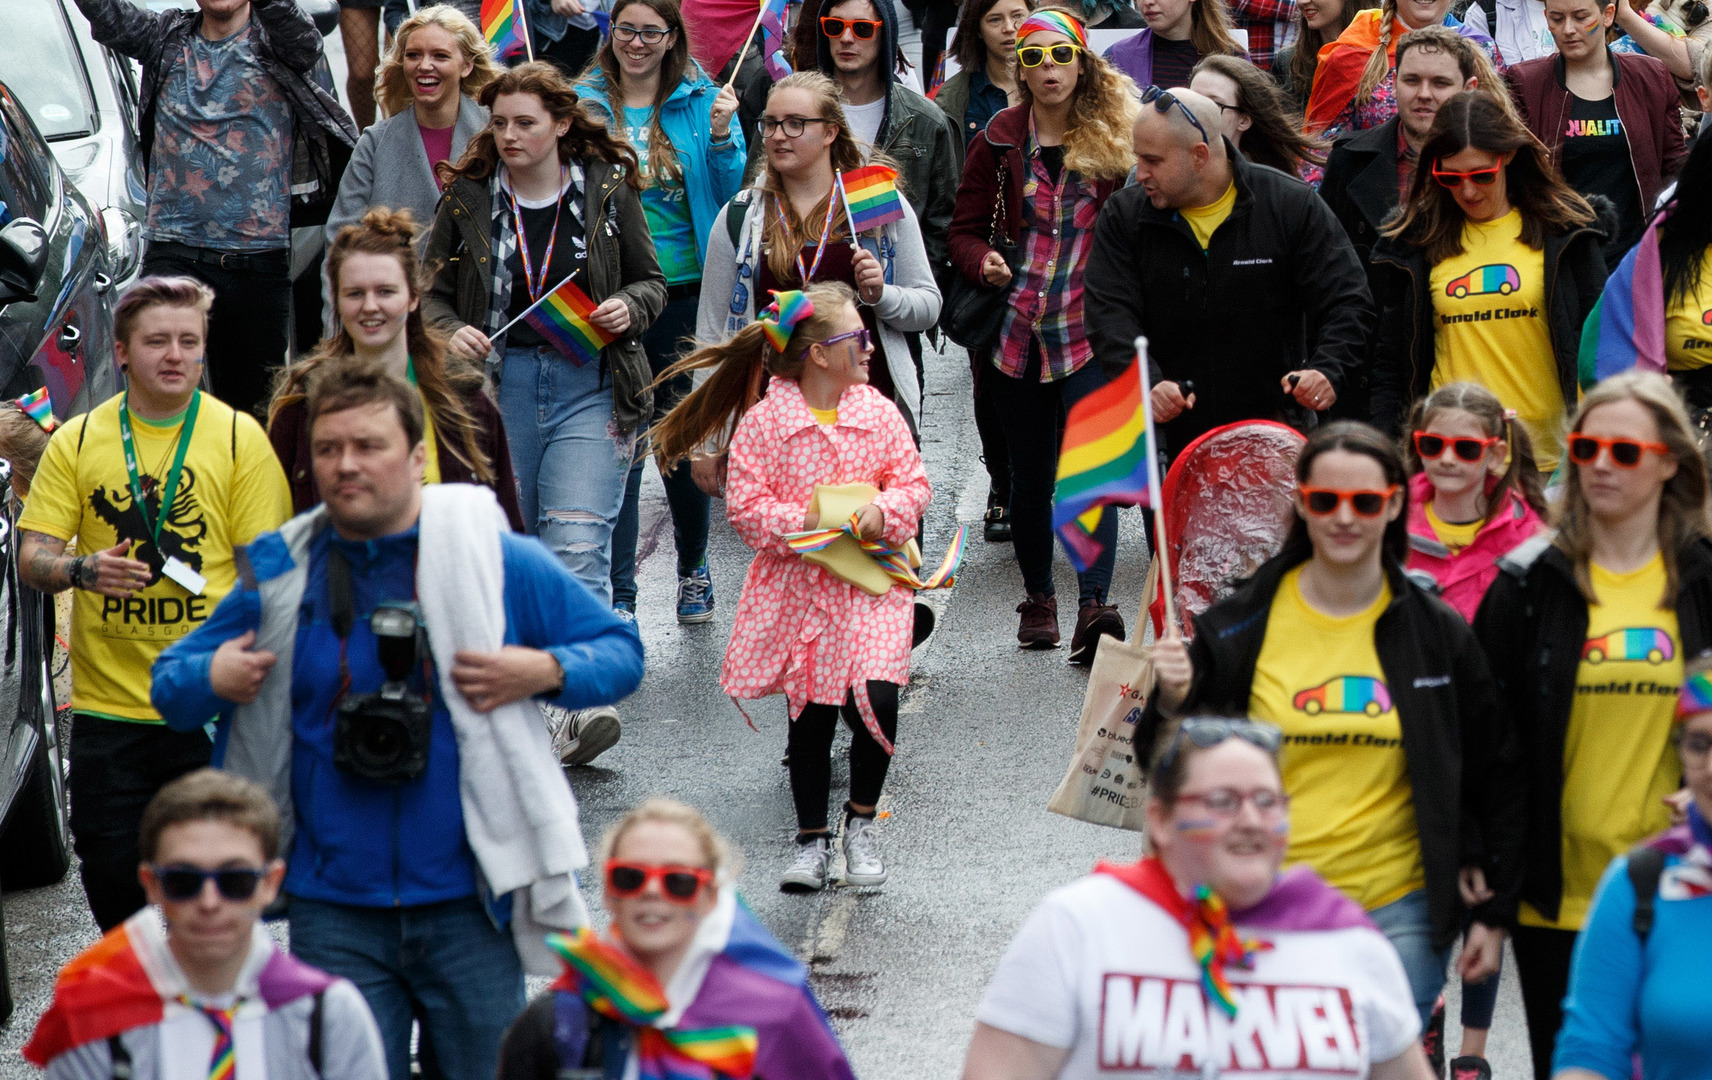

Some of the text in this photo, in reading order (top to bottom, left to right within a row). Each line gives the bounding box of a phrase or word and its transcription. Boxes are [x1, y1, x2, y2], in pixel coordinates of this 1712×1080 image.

[1565, 119, 1621, 138] QUALIT
[1494, 306, 1539, 322] Clark
[102, 594, 209, 625] PRIDE
[101, 623, 204, 637] GLASGO
[1577, 682, 1681, 695] nold Clar
[1284, 733, 1400, 747] rnold Clar
[1101, 974, 1360, 1072] MARVEL
